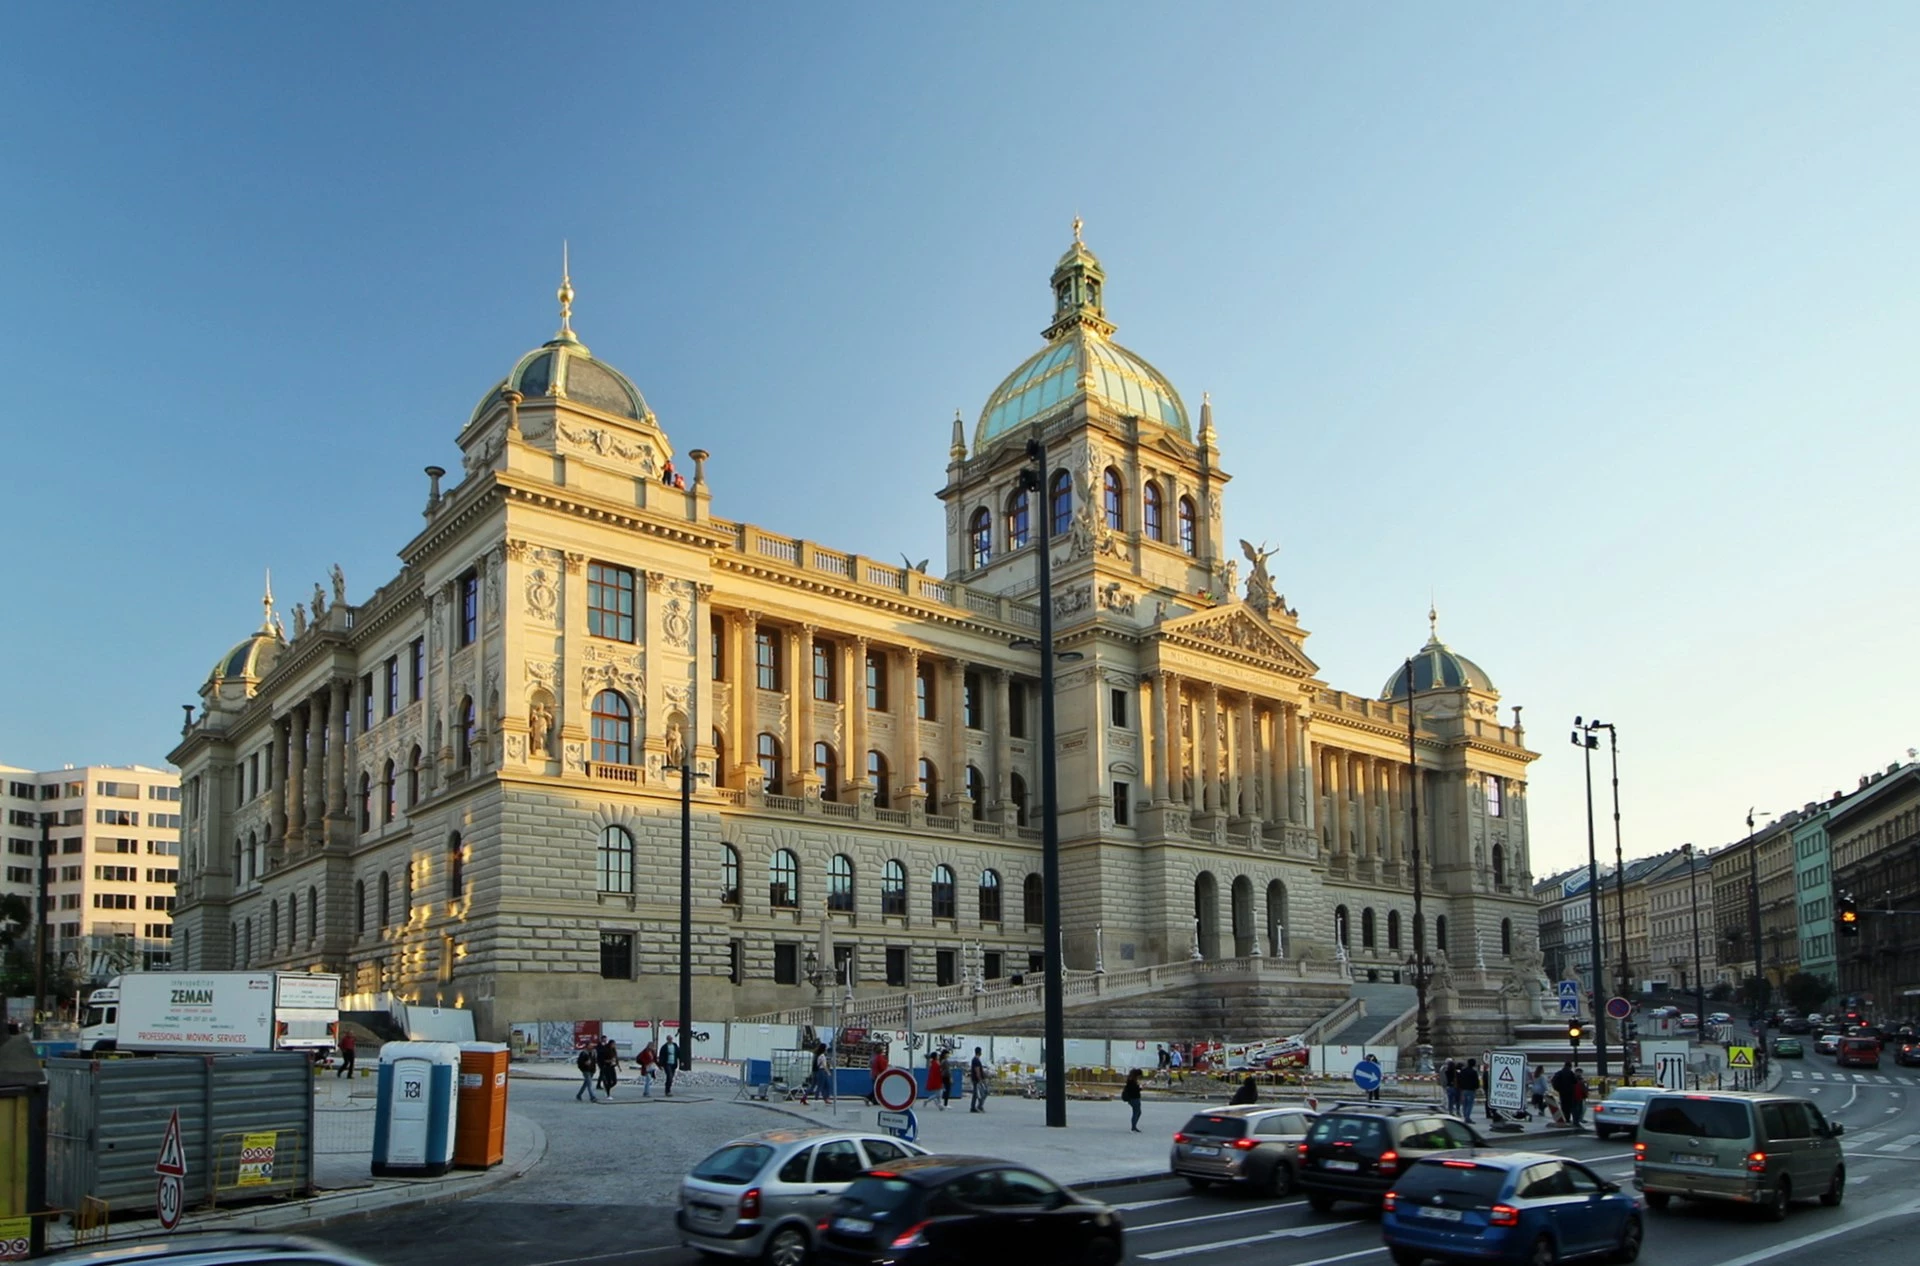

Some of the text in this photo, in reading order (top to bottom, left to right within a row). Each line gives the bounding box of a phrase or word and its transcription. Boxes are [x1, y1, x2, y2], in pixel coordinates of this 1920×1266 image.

[171, 989, 213, 1003] ZEMAN
[138, 1032, 246, 1043] PROFESSIONAL MOVING SERVICES
[1494, 1056, 1521, 1065] POZOR
[162, 1183, 177, 1213] 30
